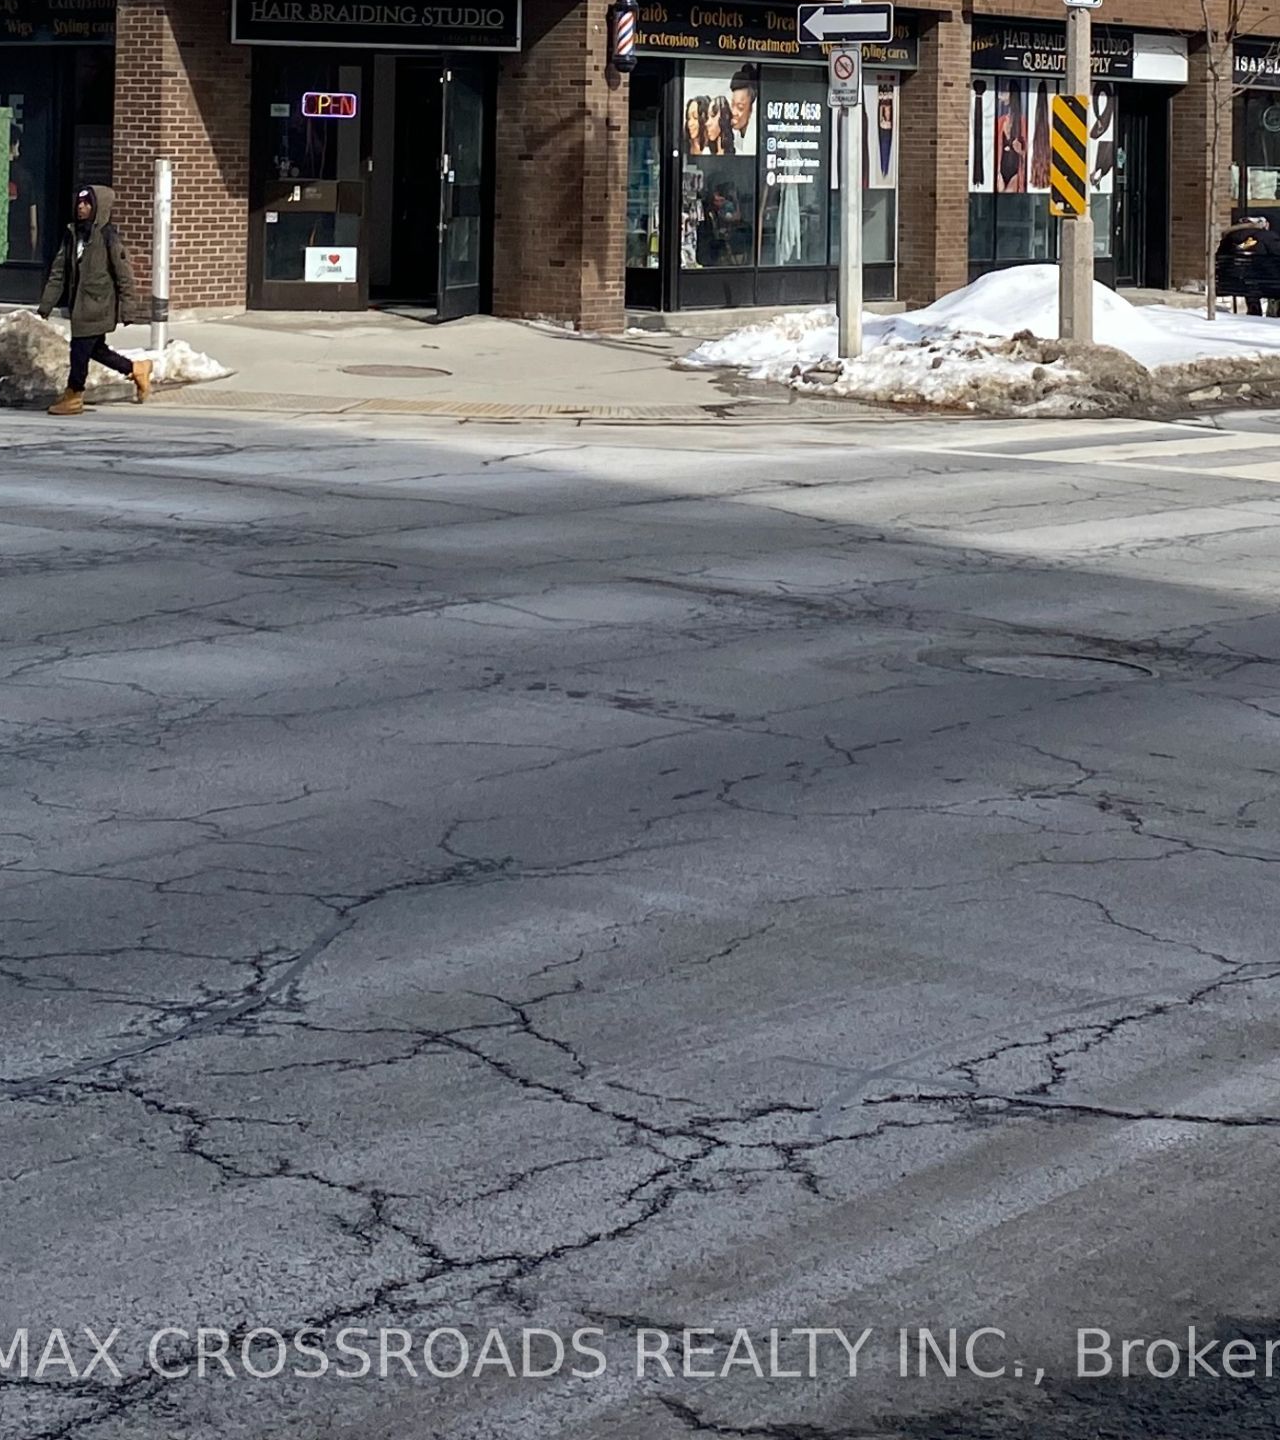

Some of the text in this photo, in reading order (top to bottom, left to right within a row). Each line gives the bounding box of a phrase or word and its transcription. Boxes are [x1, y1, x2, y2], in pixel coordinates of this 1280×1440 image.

[250, 0, 505, 27] HAIR BRAIDING STUDIO
[636, 3, 668, 23] raids
[690, 5, 744, 28] Crochets
[634, 29, 647, 46] air
[648, 32, 700, 49] extensions
[718, 34, 738, 50] Oils
[747, 36, 800, 54] treatments
[1003, 28, 1032, 50] HAIR
[1033, 31, 1067, 51] BRAID
[1034, 53, 1067, 71] BEAUT
[767, 101, 783, 120] 647
